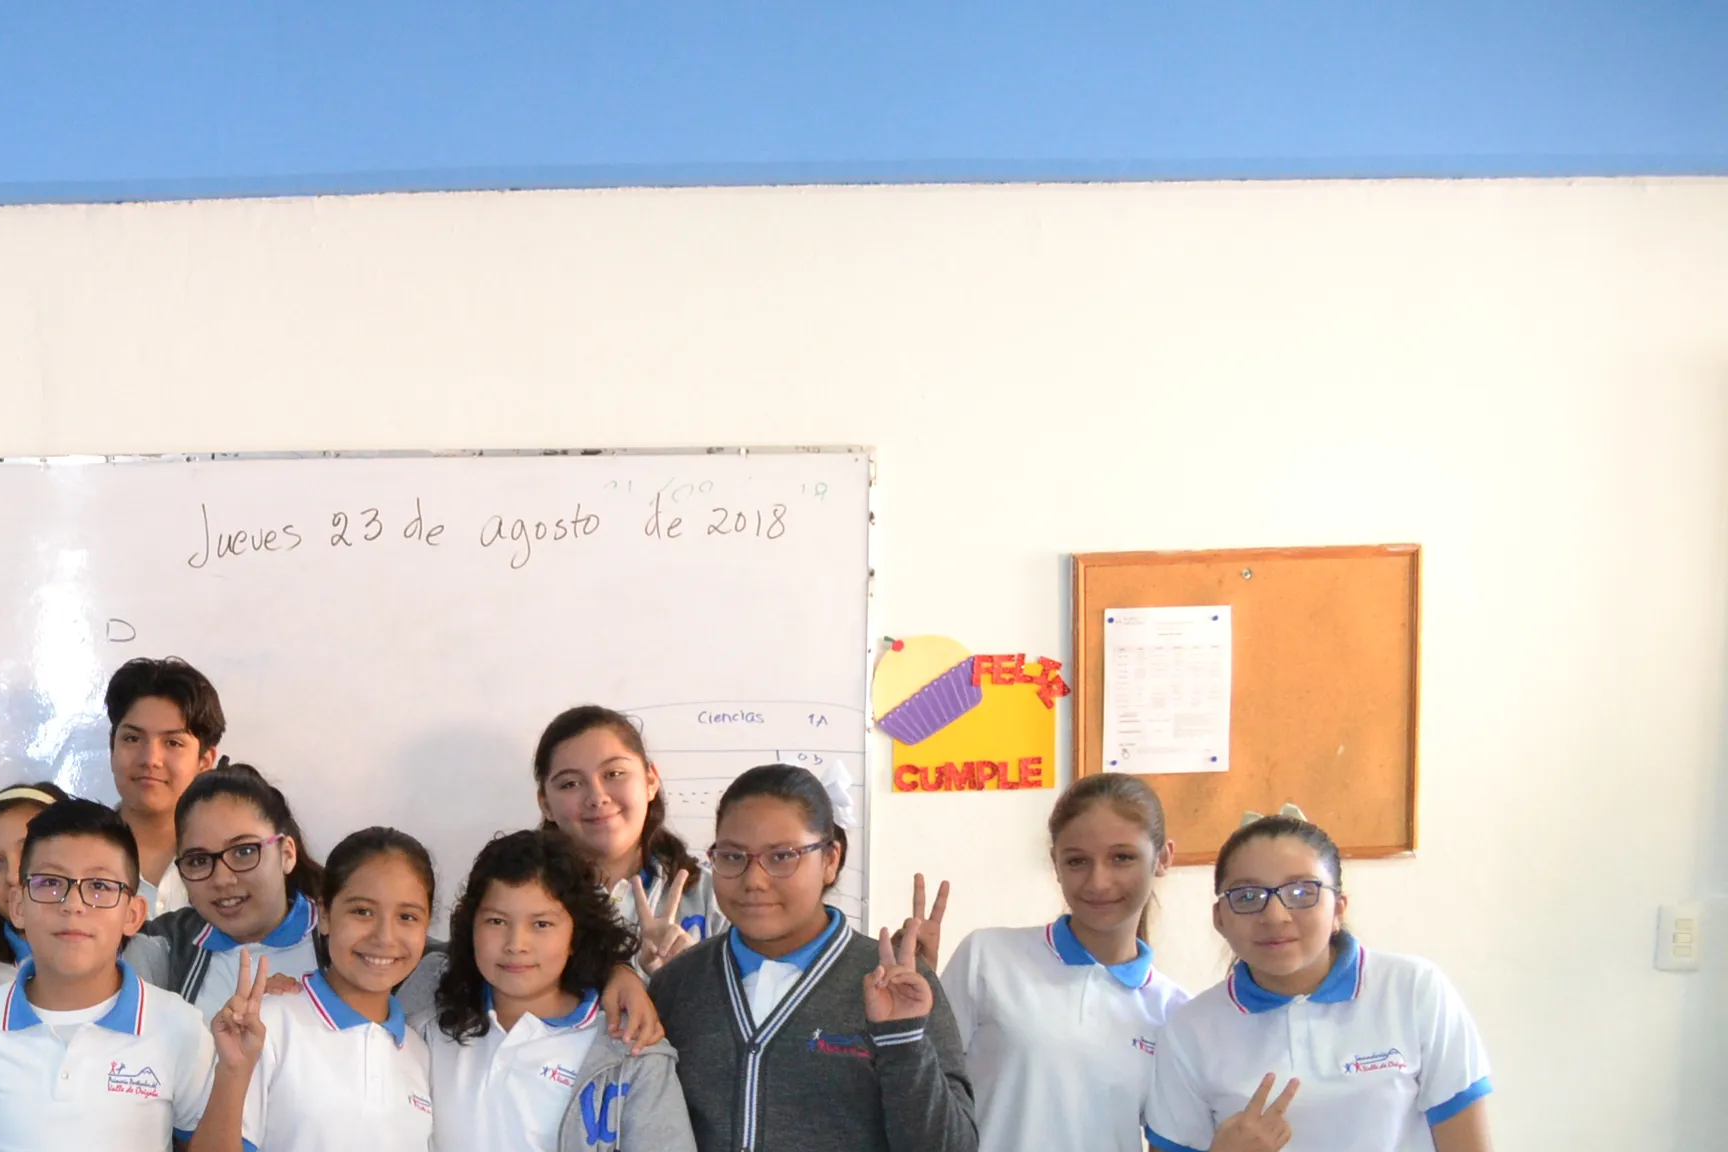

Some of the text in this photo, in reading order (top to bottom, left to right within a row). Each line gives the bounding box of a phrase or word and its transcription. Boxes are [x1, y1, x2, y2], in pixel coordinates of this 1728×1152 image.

[188, 491, 786, 570] Jueves 23 de agosto de 2018
[106, 618, 136, 642] D
[972, 653, 1071, 710] FELIZ
[697, 710, 765, 724] Ciencias
[894, 756, 1043, 793] CUMPLE
